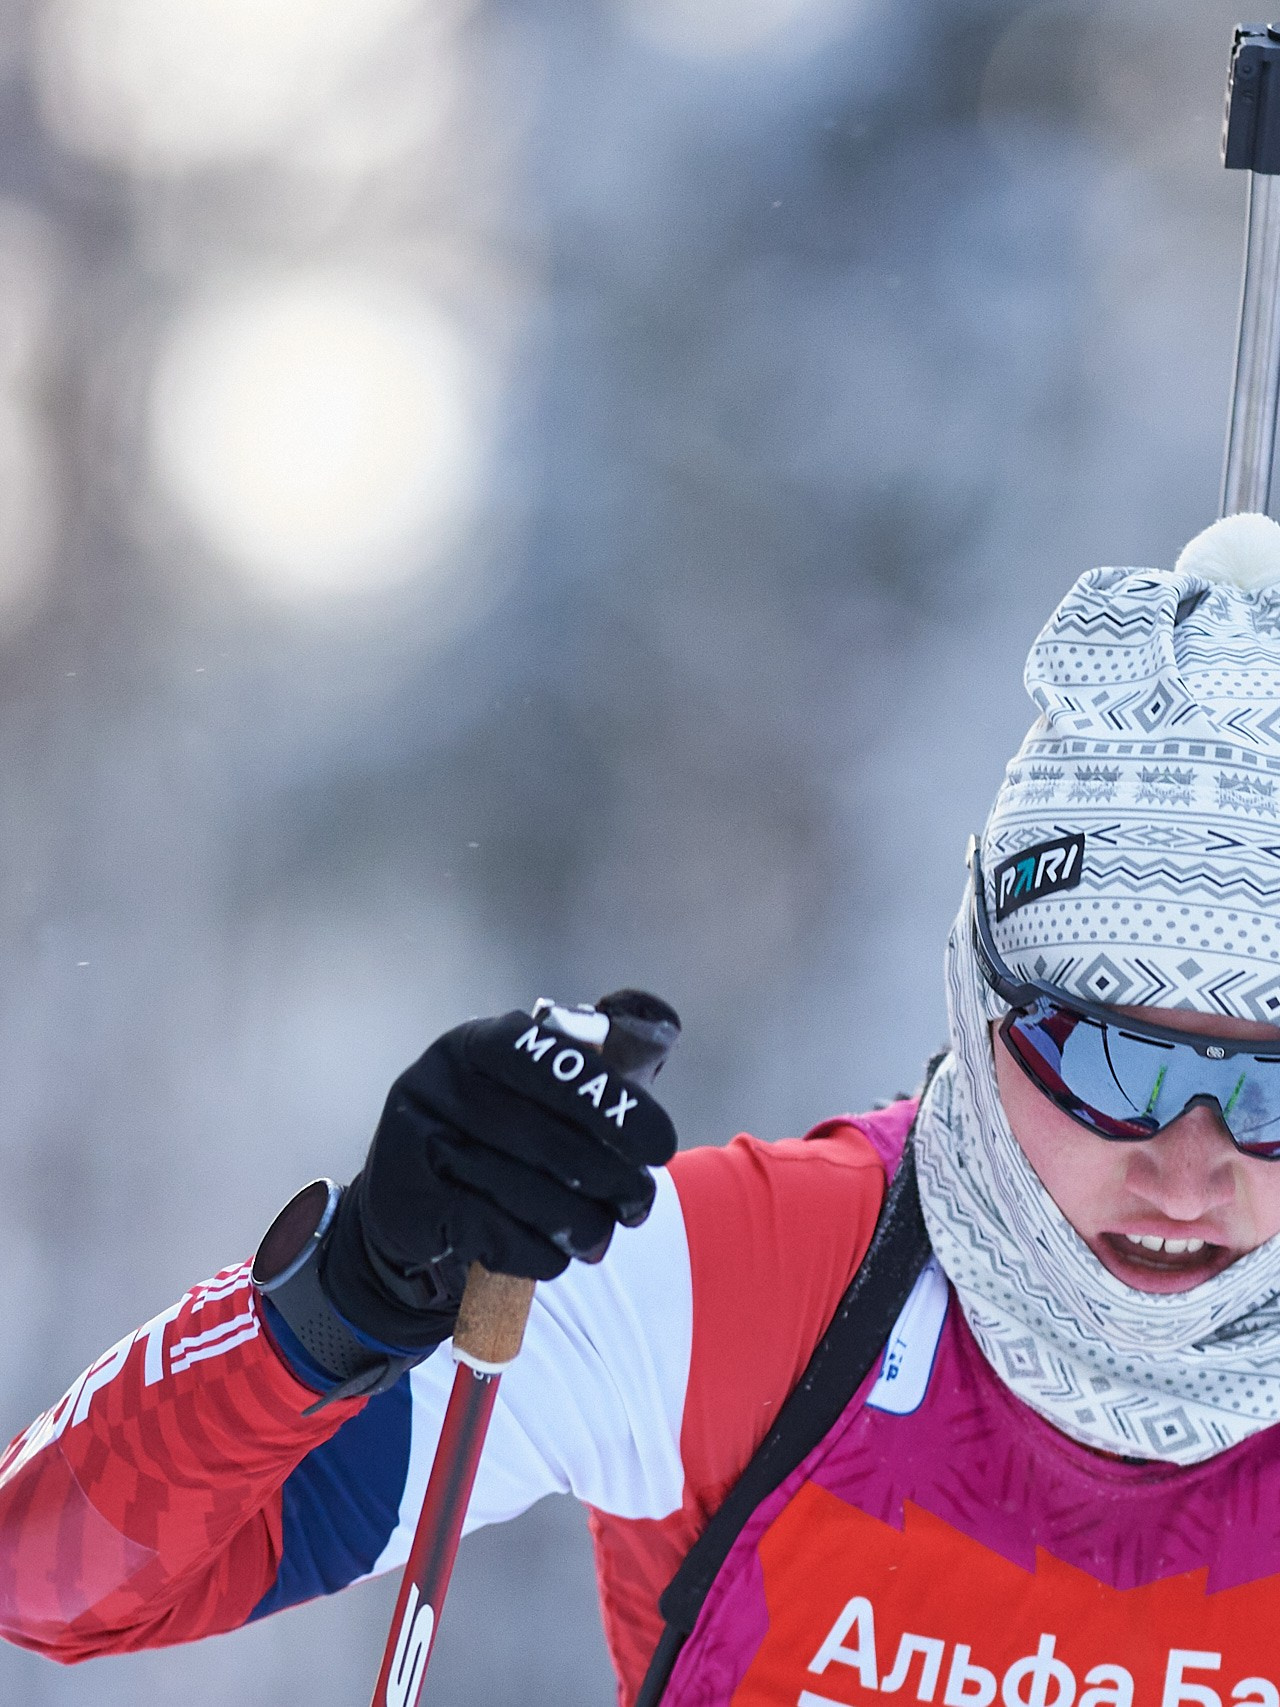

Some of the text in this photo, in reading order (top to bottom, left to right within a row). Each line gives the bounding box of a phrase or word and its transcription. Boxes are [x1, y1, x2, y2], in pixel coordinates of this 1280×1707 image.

[999, 843, 1079, 909] PARI
[514, 1025, 639, 1128] MOAX
[806, 1595, 1135, 1707] Альфа
